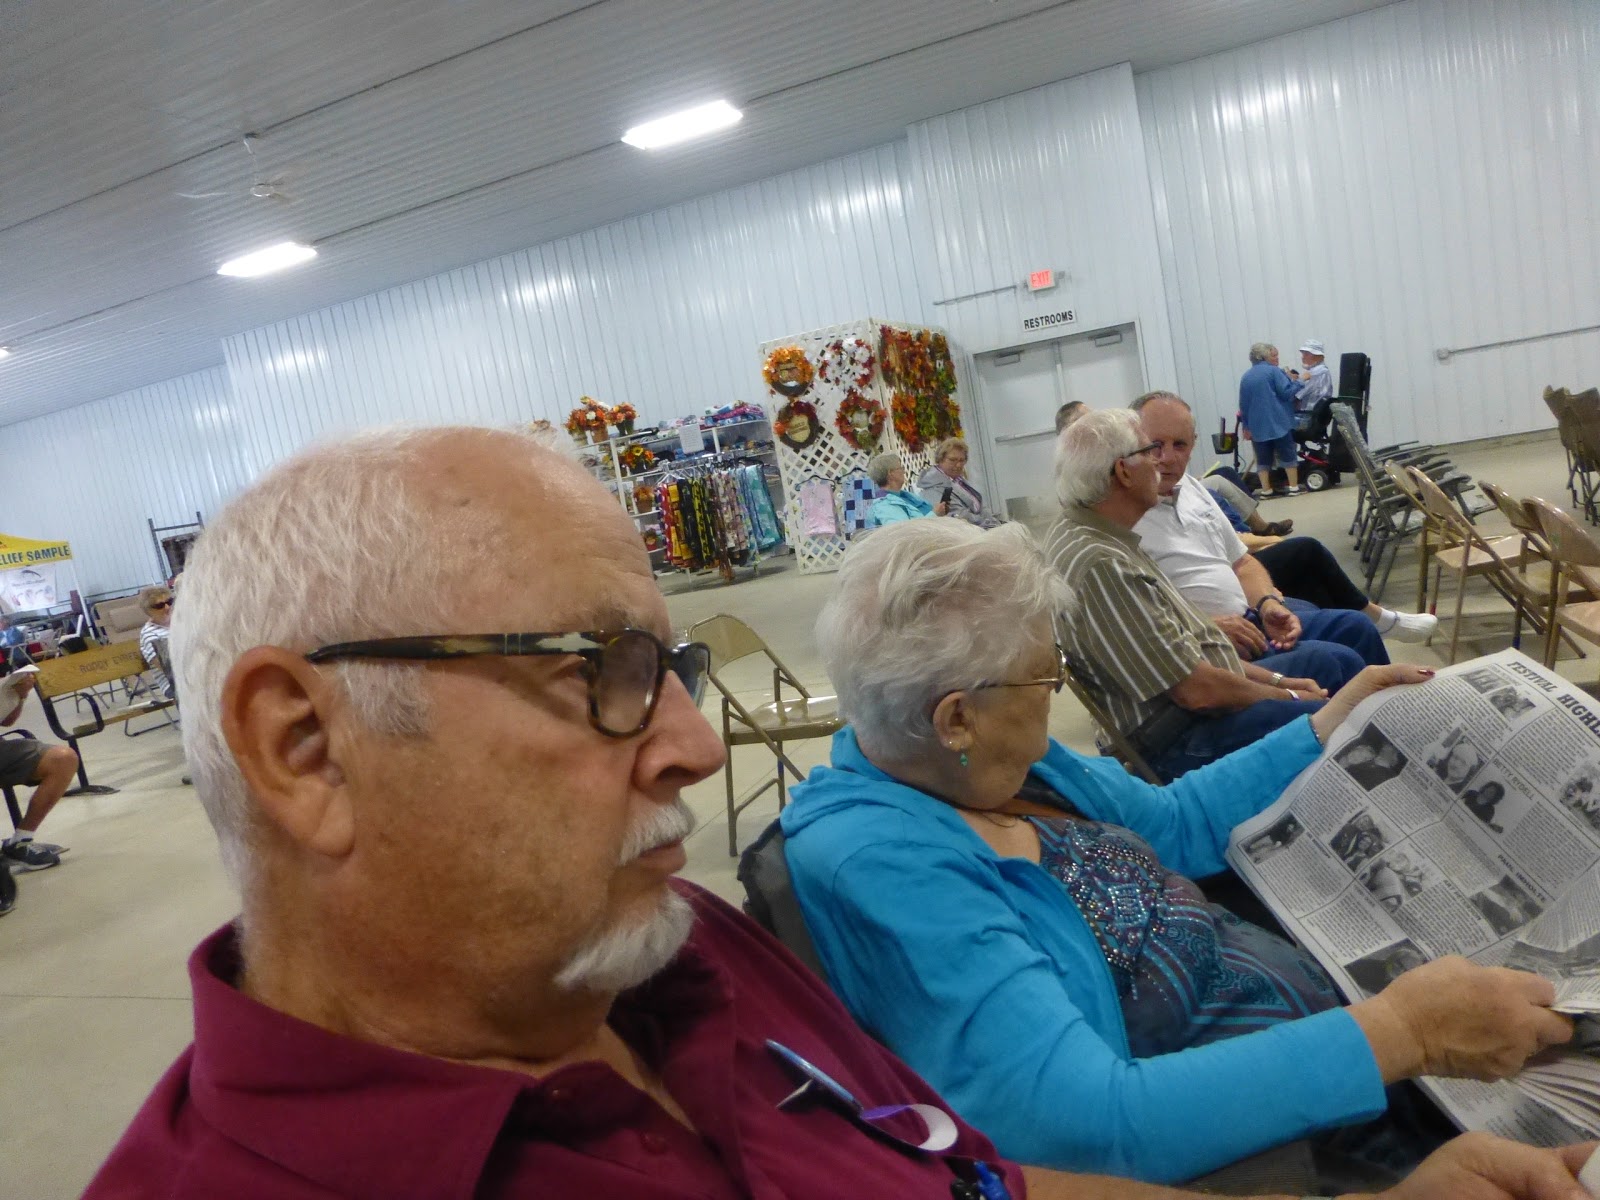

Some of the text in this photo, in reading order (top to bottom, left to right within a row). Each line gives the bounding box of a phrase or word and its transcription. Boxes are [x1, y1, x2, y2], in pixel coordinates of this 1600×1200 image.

[1031, 270, 1051, 285] EXIT
[1024, 310, 1073, 330] RESTROOMS
[26, 545, 70, 561] SAMPLE
[1507, 661, 1558, 692] FESTIVAL
[1557, 693, 1600, 738] HIGHL
